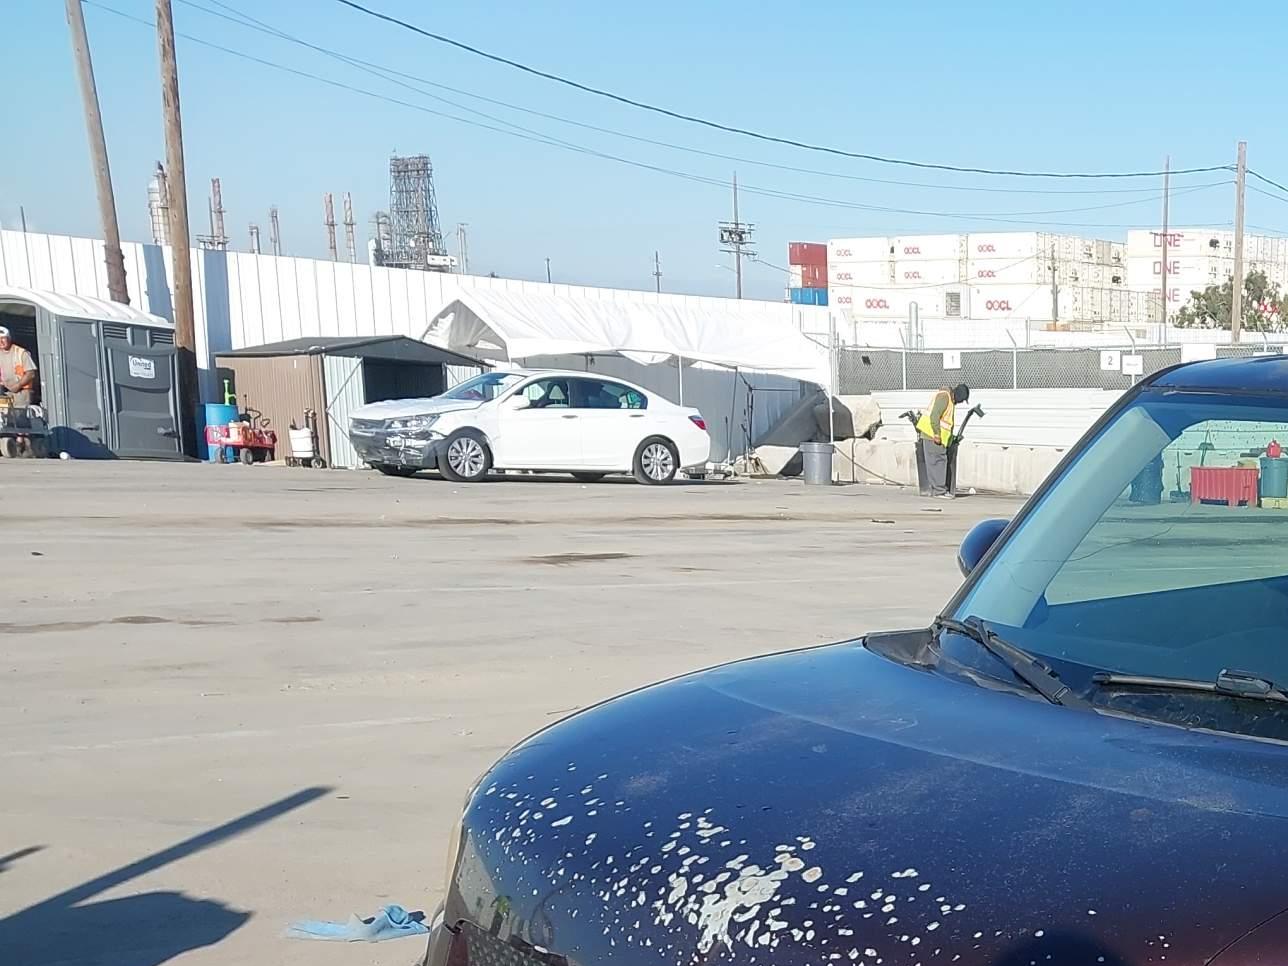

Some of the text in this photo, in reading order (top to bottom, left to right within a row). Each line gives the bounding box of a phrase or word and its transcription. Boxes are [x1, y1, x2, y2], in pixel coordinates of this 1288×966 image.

[904, 246, 922, 256] OOCL
[978, 244, 997, 254] OOCL
[1153, 261, 1181, 275] ONE
[904, 271, 923, 280] OOCL
[978, 270, 997, 279] OOCL
[865, 299, 891, 310] OOCL
[986, 299, 1013, 312] OOCL
[1107, 355, 1114, 366] 2
